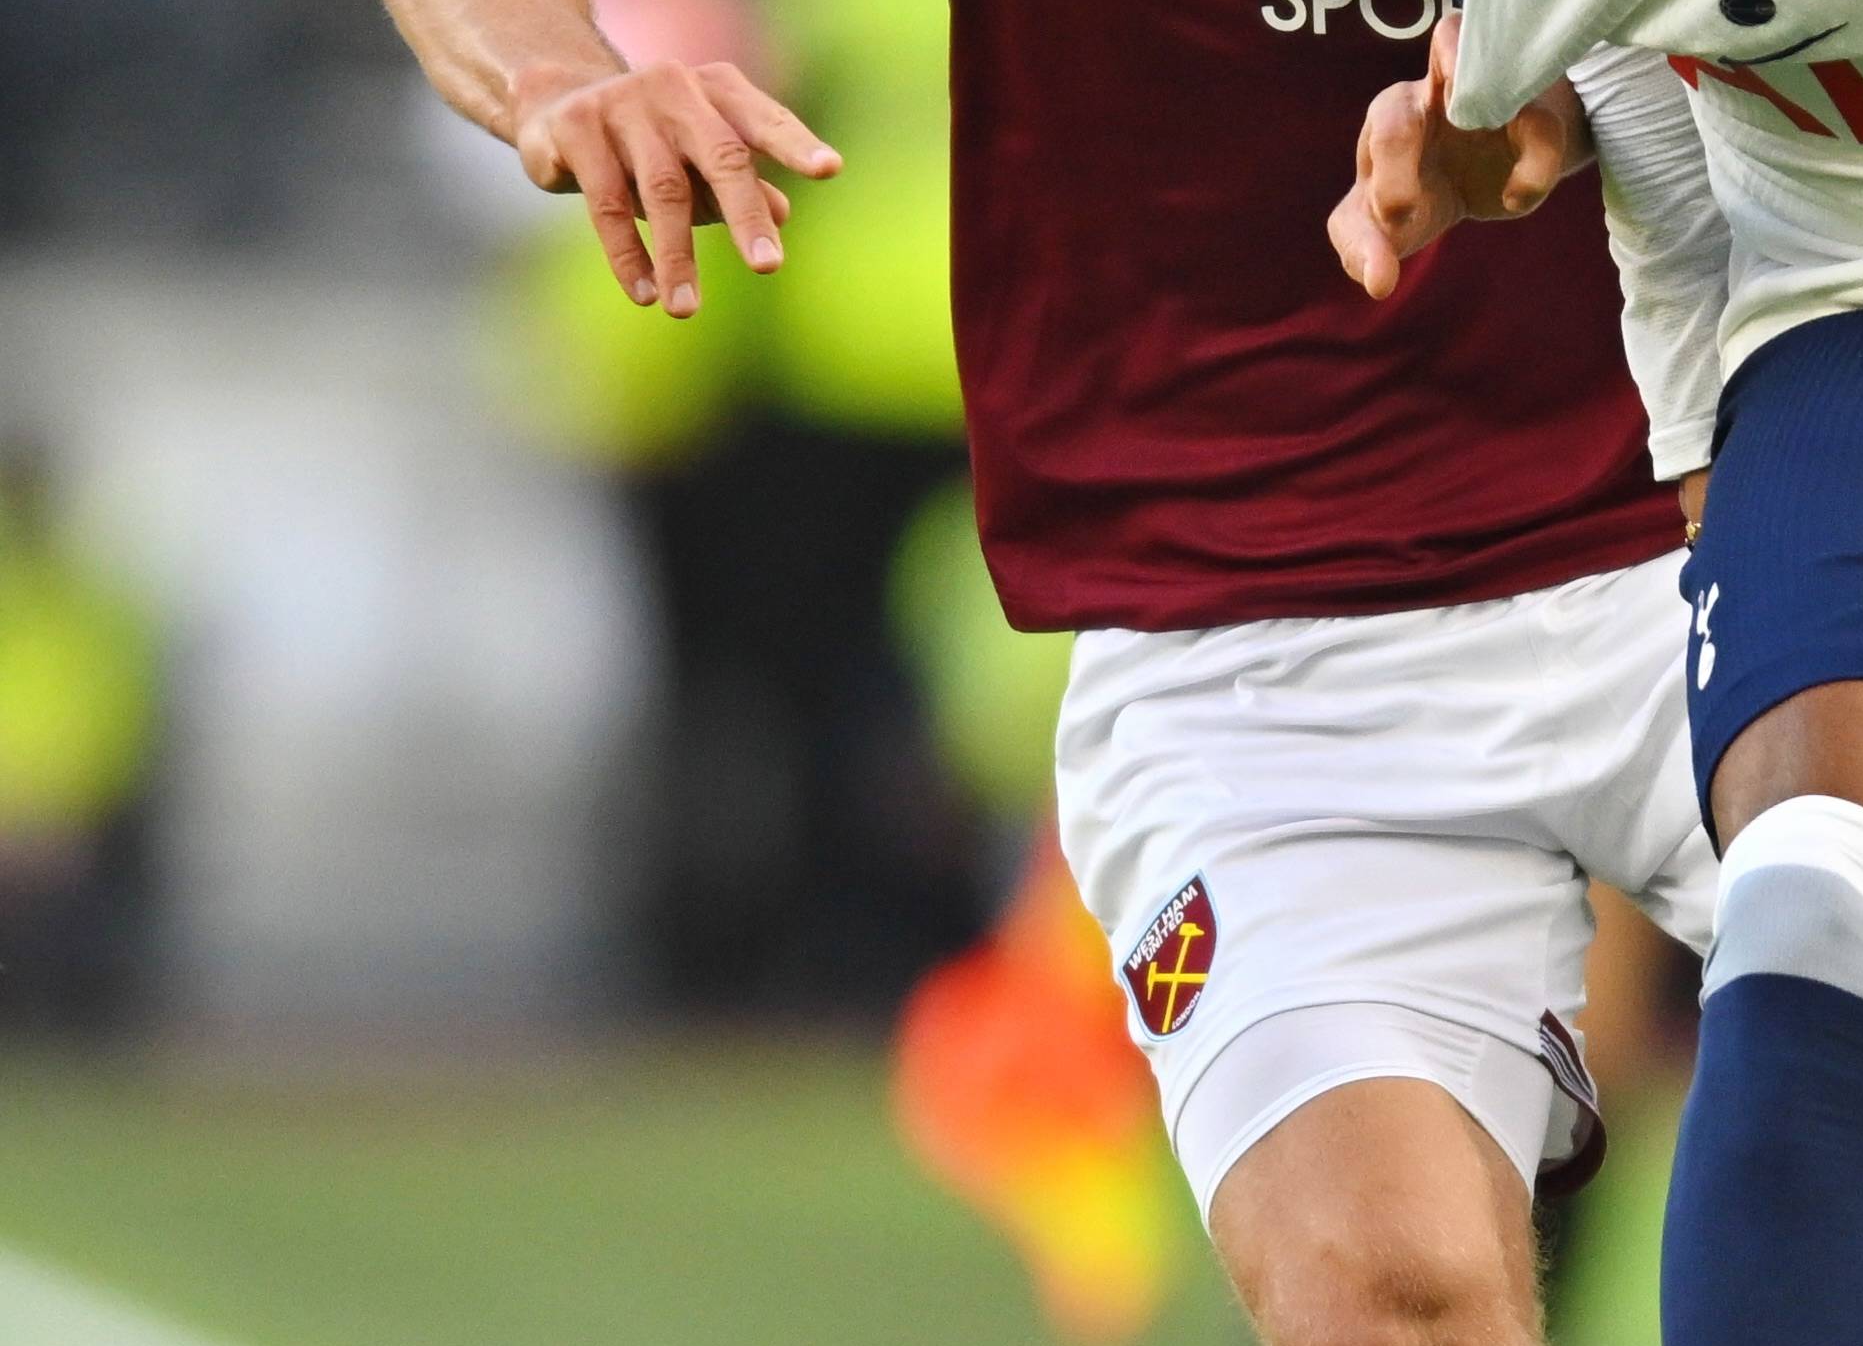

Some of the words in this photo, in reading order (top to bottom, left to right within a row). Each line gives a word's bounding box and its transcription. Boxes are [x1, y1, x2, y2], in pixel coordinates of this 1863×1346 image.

[1128, 919, 1162, 970] WEST
[1161, 884, 1198, 925] HAM
[1145, 911, 1184, 962] UNITED
[1172, 990, 1200, 1030] LONDON
